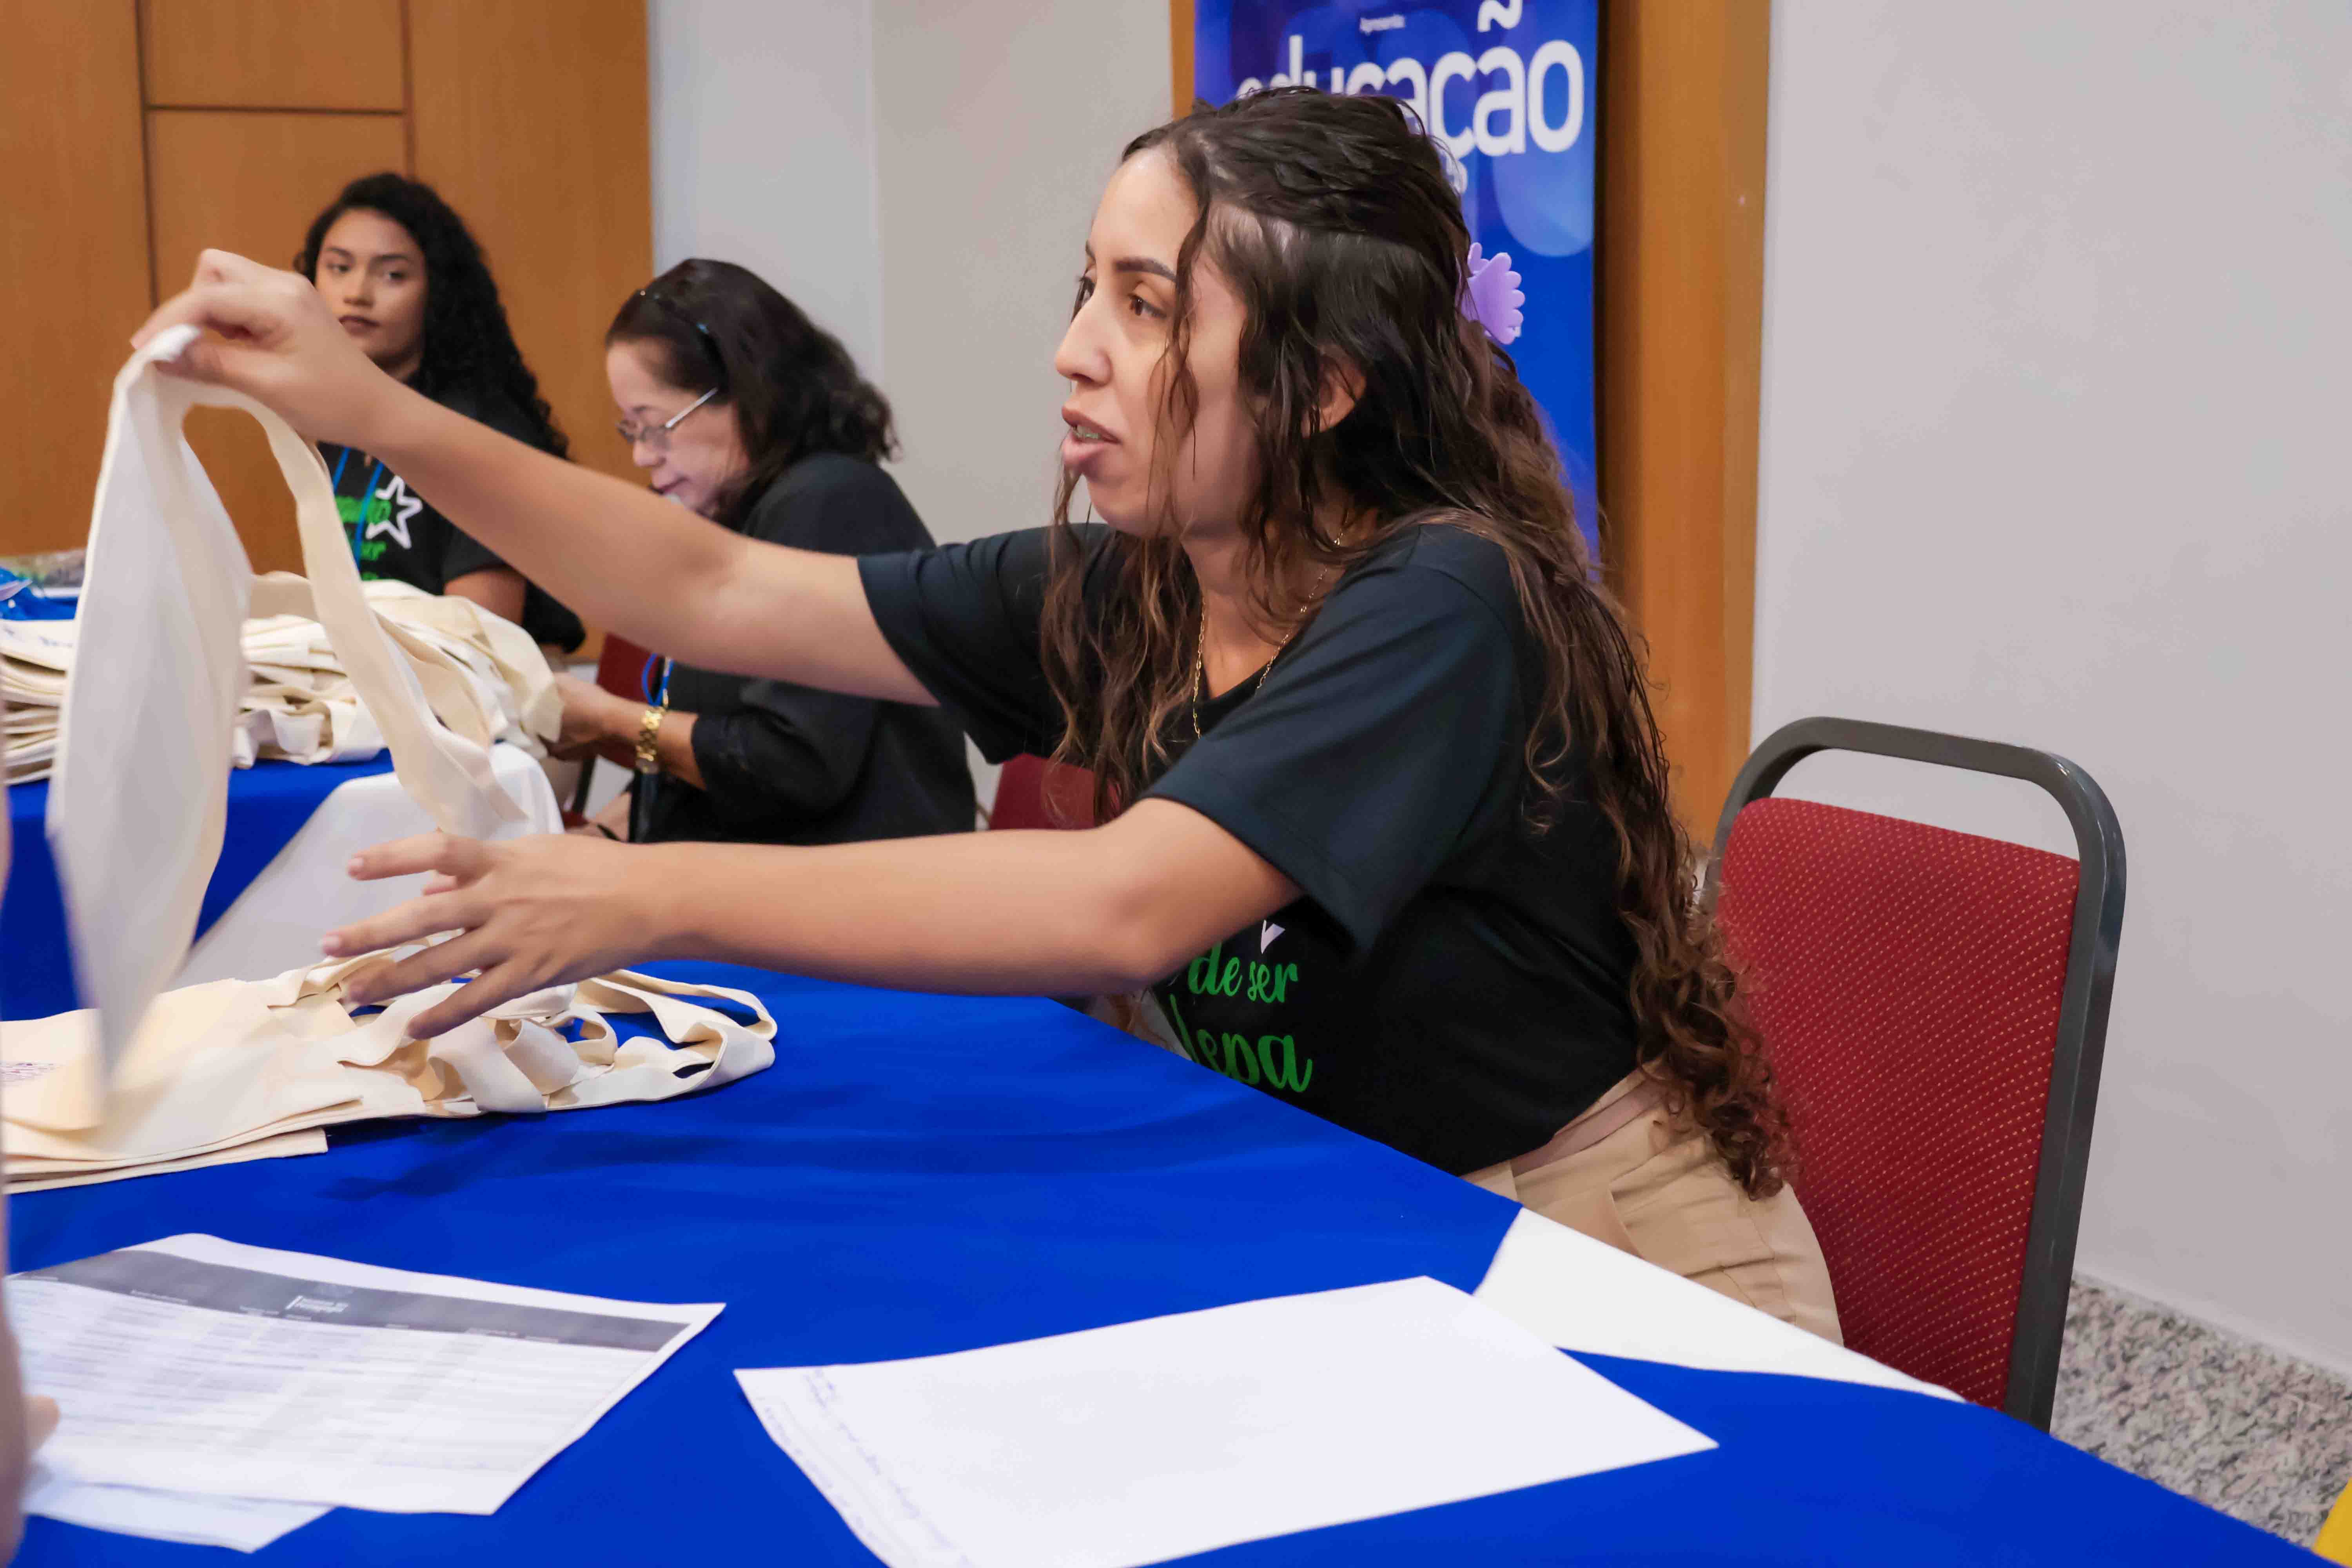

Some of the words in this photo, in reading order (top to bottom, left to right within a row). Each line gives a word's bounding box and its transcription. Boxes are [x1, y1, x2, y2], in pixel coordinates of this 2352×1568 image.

[1236, 0, 1584, 193] ação
[1188, 941, 1243, 996] de
[1247, 961, 1298, 1003] ser
